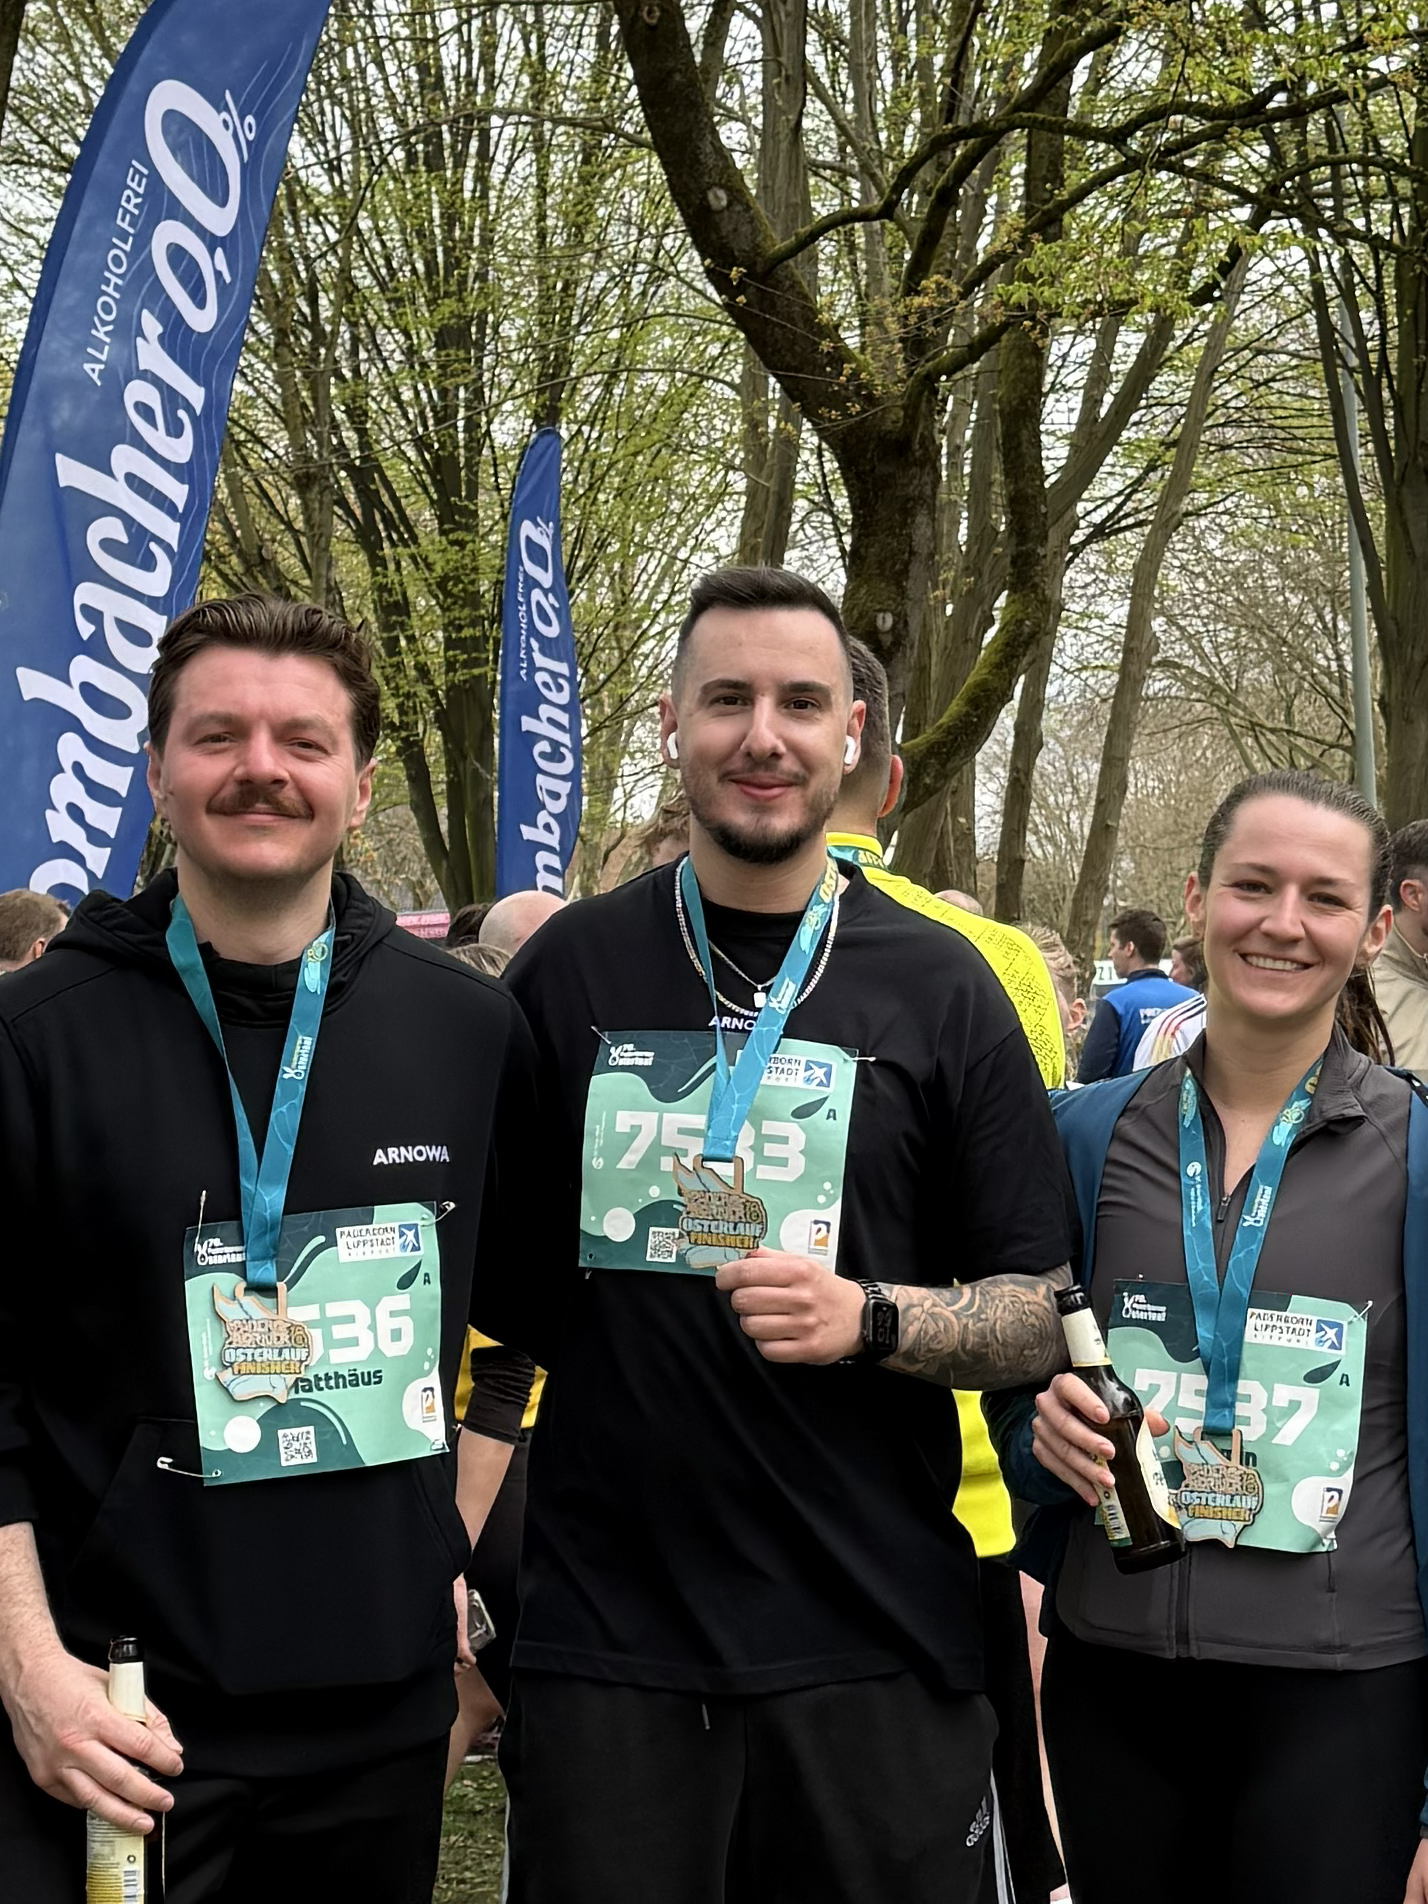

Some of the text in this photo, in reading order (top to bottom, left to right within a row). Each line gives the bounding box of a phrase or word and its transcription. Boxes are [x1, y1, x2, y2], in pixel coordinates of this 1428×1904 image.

[82, 158, 150, 388] ALKOHOLFREI
[825, 1108, 837, 1122] A
[372, 1145, 451, 1166] ARNOWA
[422, 1272, 431, 1286] A
[1338, 1372, 1350, 1387] A
